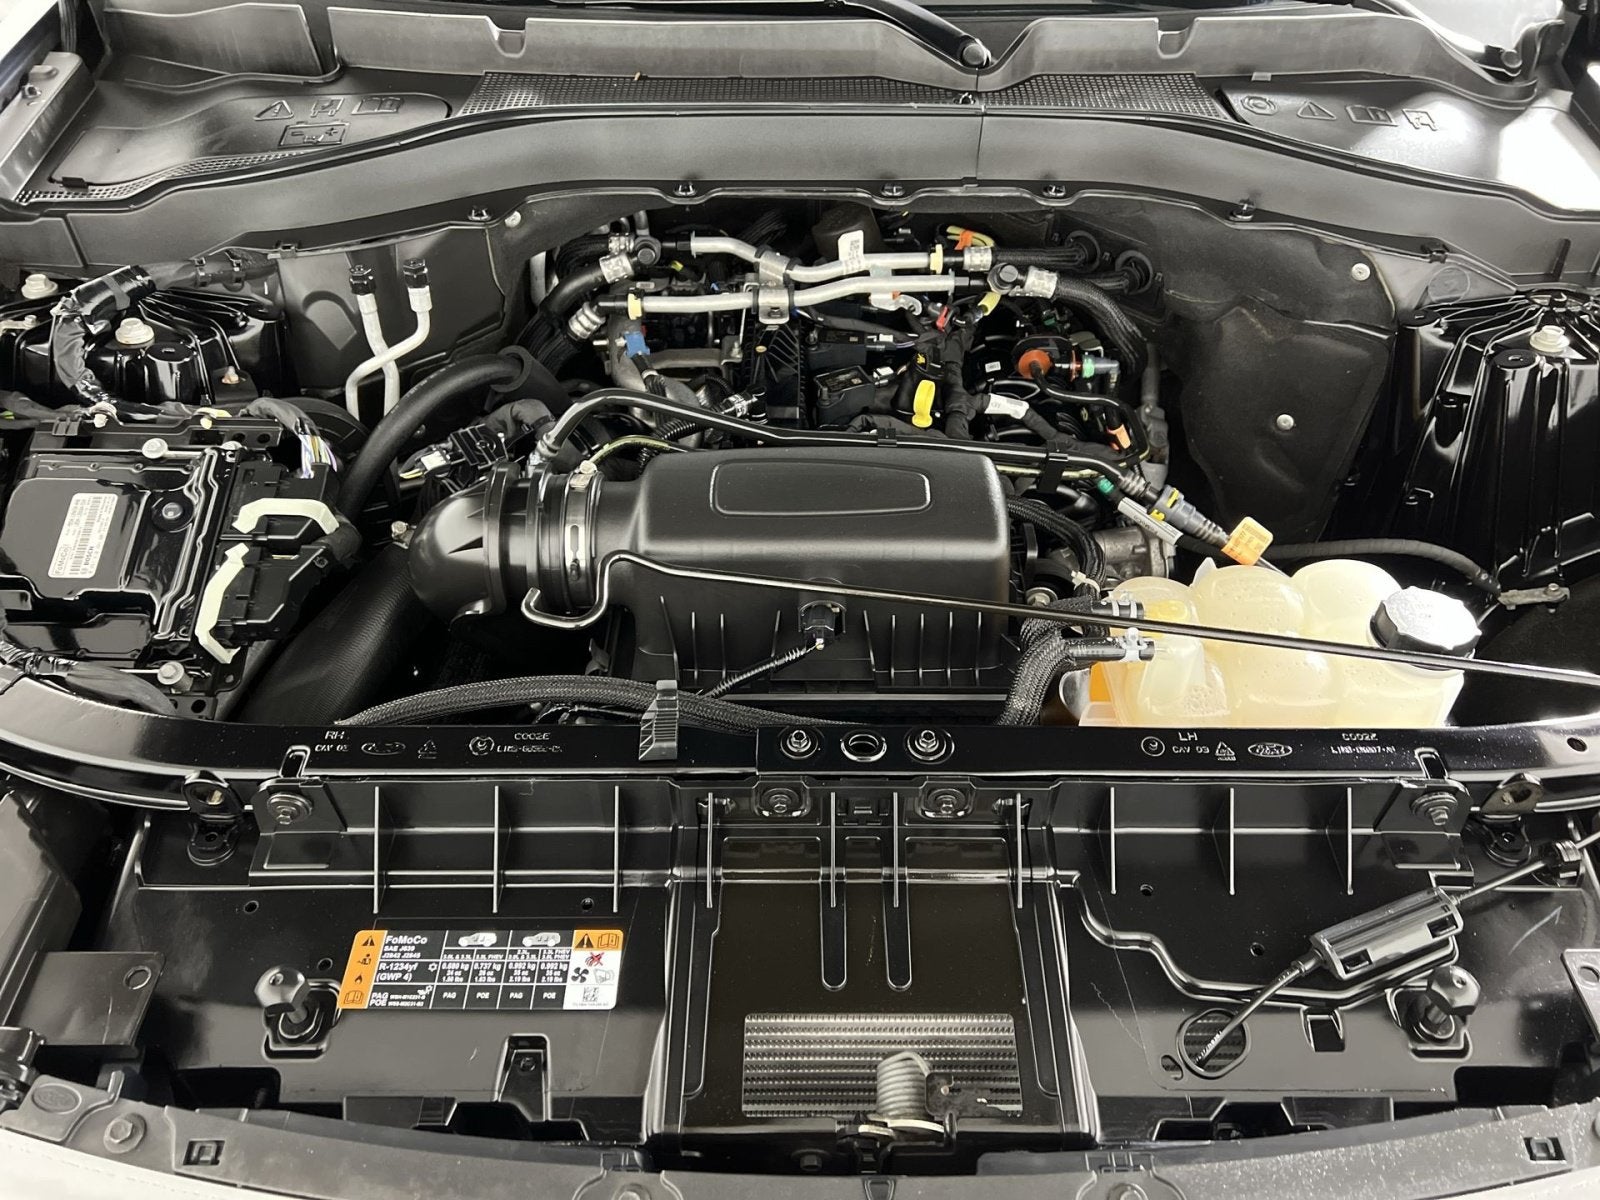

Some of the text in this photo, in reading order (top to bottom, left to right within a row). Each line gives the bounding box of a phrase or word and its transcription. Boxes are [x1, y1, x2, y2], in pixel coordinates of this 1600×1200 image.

[83, 546, 94, 565] BOSCH
[54, 547, 69, 574] FoMoCo
[324, 730, 345, 740] RH
[1178, 731, 1198, 742] LH
[1172, 745, 1210, 754] CAV 03
[385, 935, 428, 944] FoMoCo
[378, 962, 419, 972] R-1234yf
[460, 962, 470, 971] kg
[473, 962, 502, 971] 0.737 kg
[527, 962, 536, 971] kg
[559, 962, 568, 971] kg
[375, 972, 413, 982] (GWP 4)
[369, 998, 388, 1006] POE
